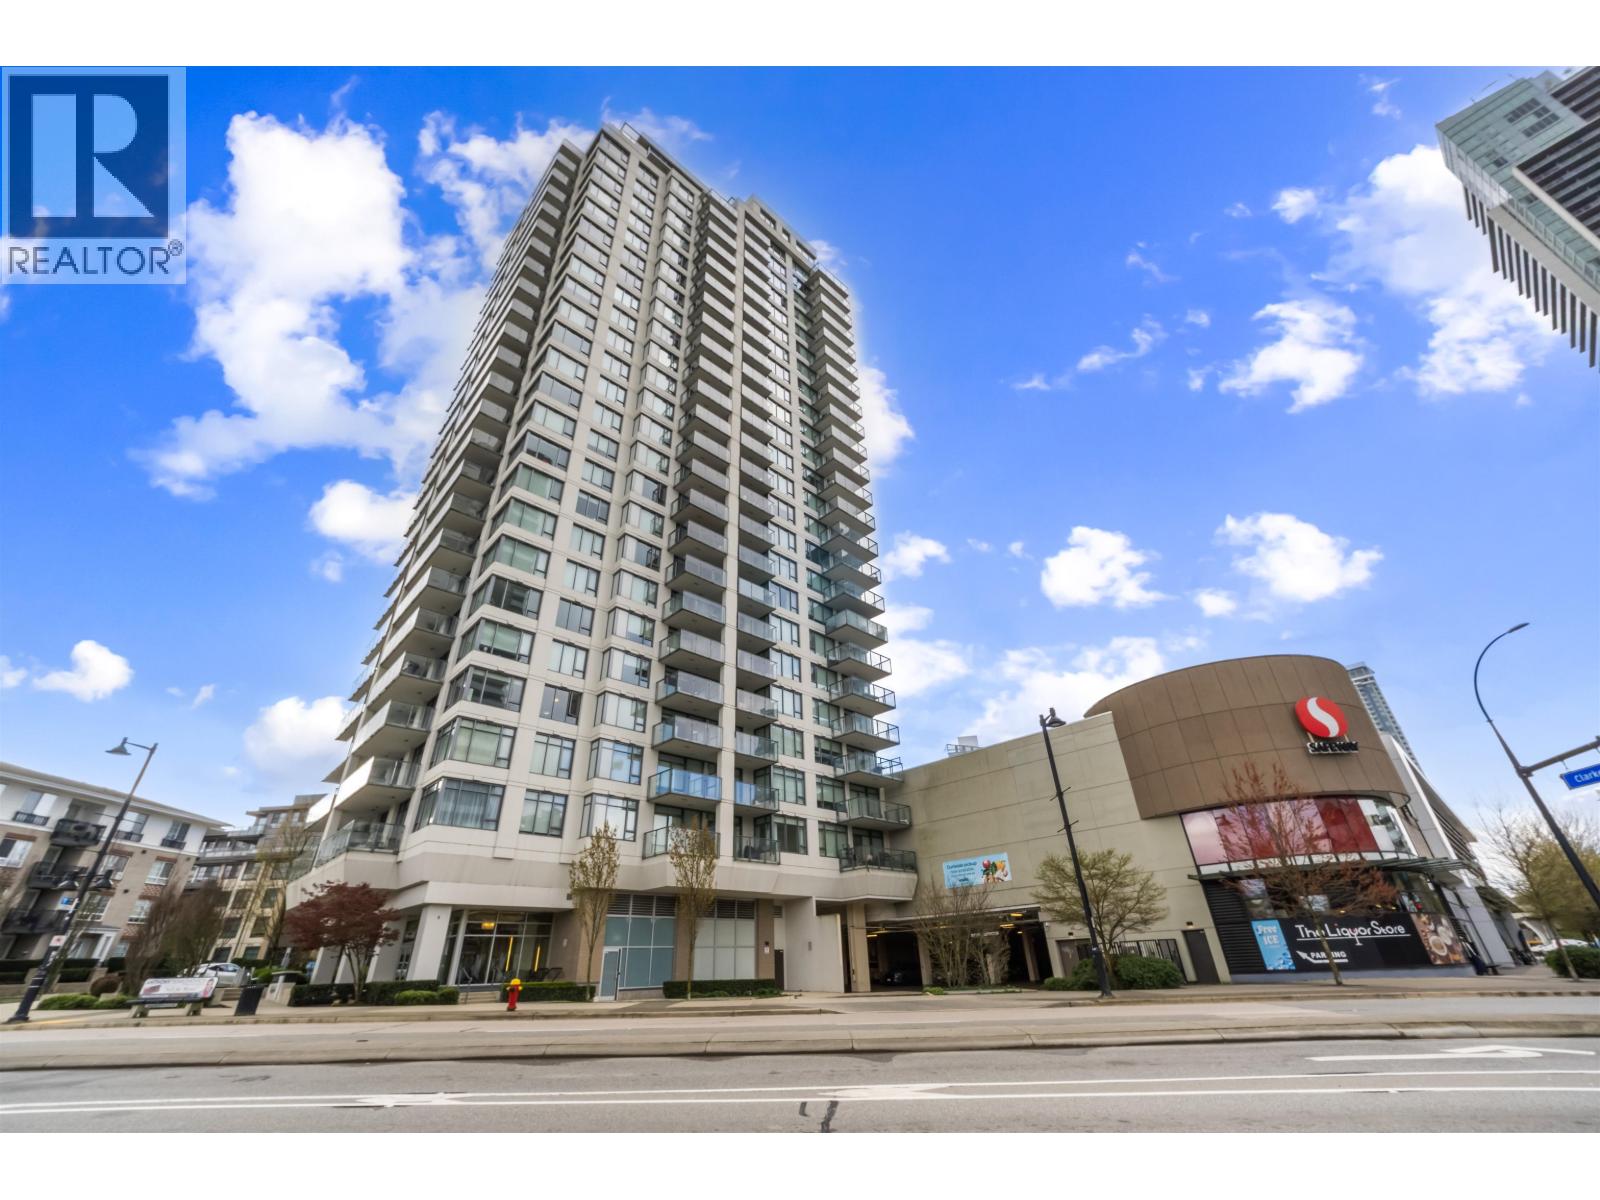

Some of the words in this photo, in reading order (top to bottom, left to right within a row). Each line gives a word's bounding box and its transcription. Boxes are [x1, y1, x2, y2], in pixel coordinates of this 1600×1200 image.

[1324, 922, 1372, 946] Liquor
[1370, 920, 1406, 936] Store
[1264, 934, 1281, 946] ICE
[1310, 951, 1347, 960] PARING
